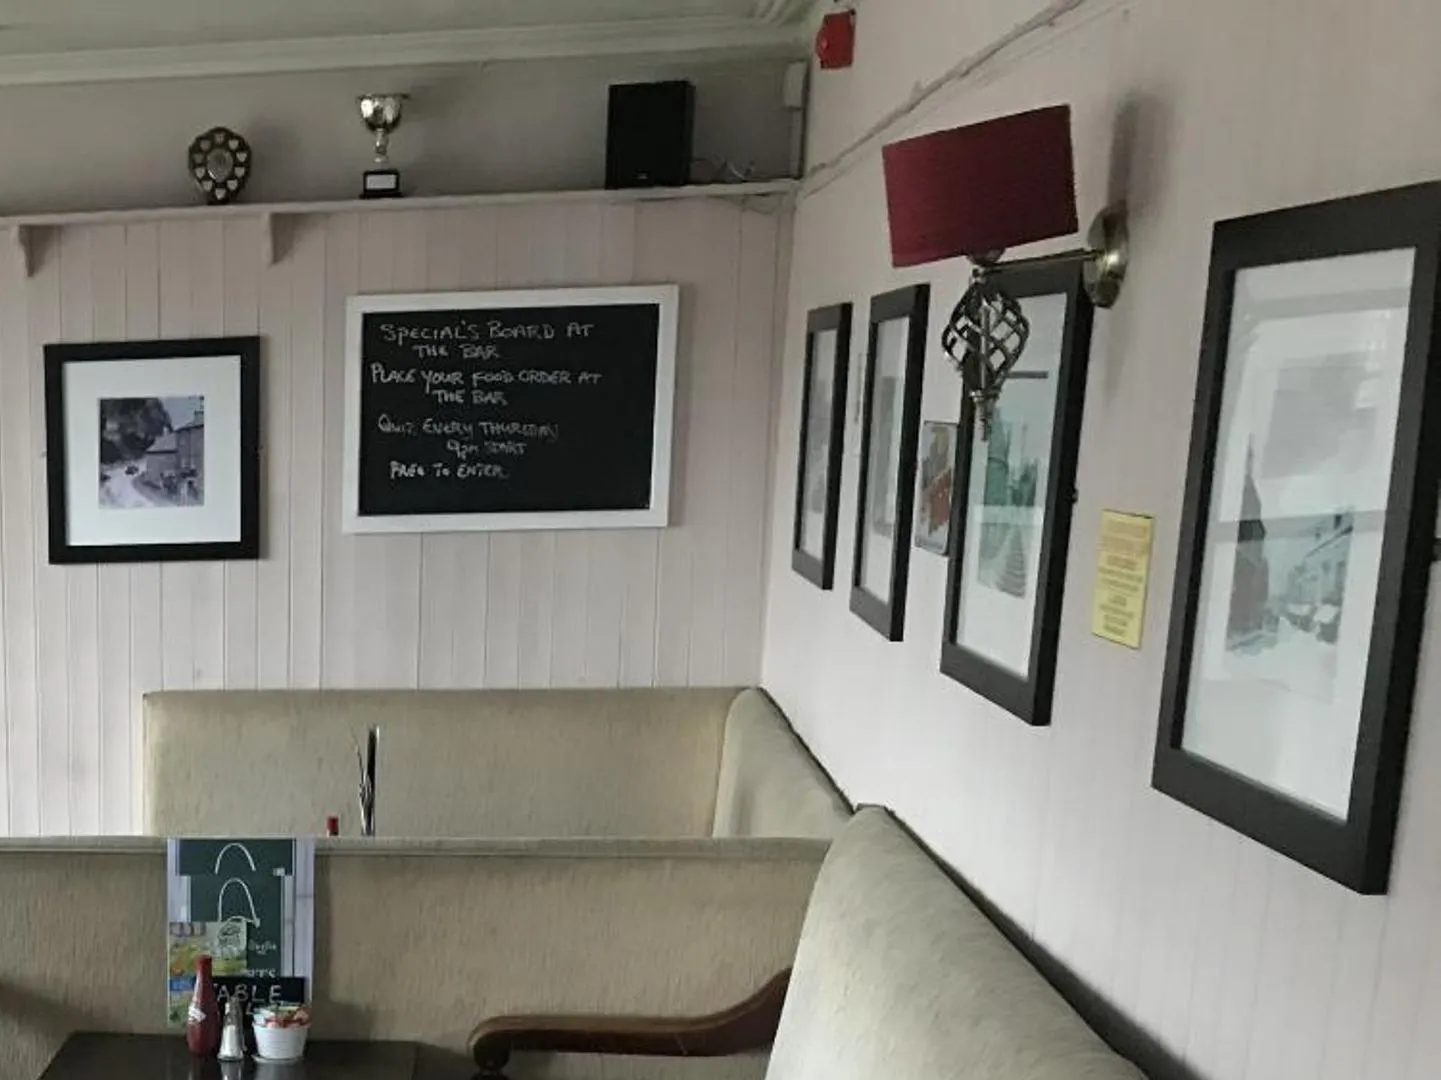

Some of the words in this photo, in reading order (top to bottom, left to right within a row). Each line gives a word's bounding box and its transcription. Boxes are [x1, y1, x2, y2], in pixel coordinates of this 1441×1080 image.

[487, 320, 554, 339] BOARD
[566, 322, 594, 337] AT
[412, 344, 448, 358] THE
[459, 344, 499, 359] BAR
[371, 362, 417, 383] PLACE
[421, 369, 464, 393] YOUR
[472, 370, 514, 387] FOOD
[518, 371, 572, 384] ORDER
[578, 372, 603, 384] AT
[433, 389, 464, 403] THE
[473, 390, 508, 405] BAR
[422, 418, 473, 439] EVERY
[213, 984, 282, 1003] ABLE
